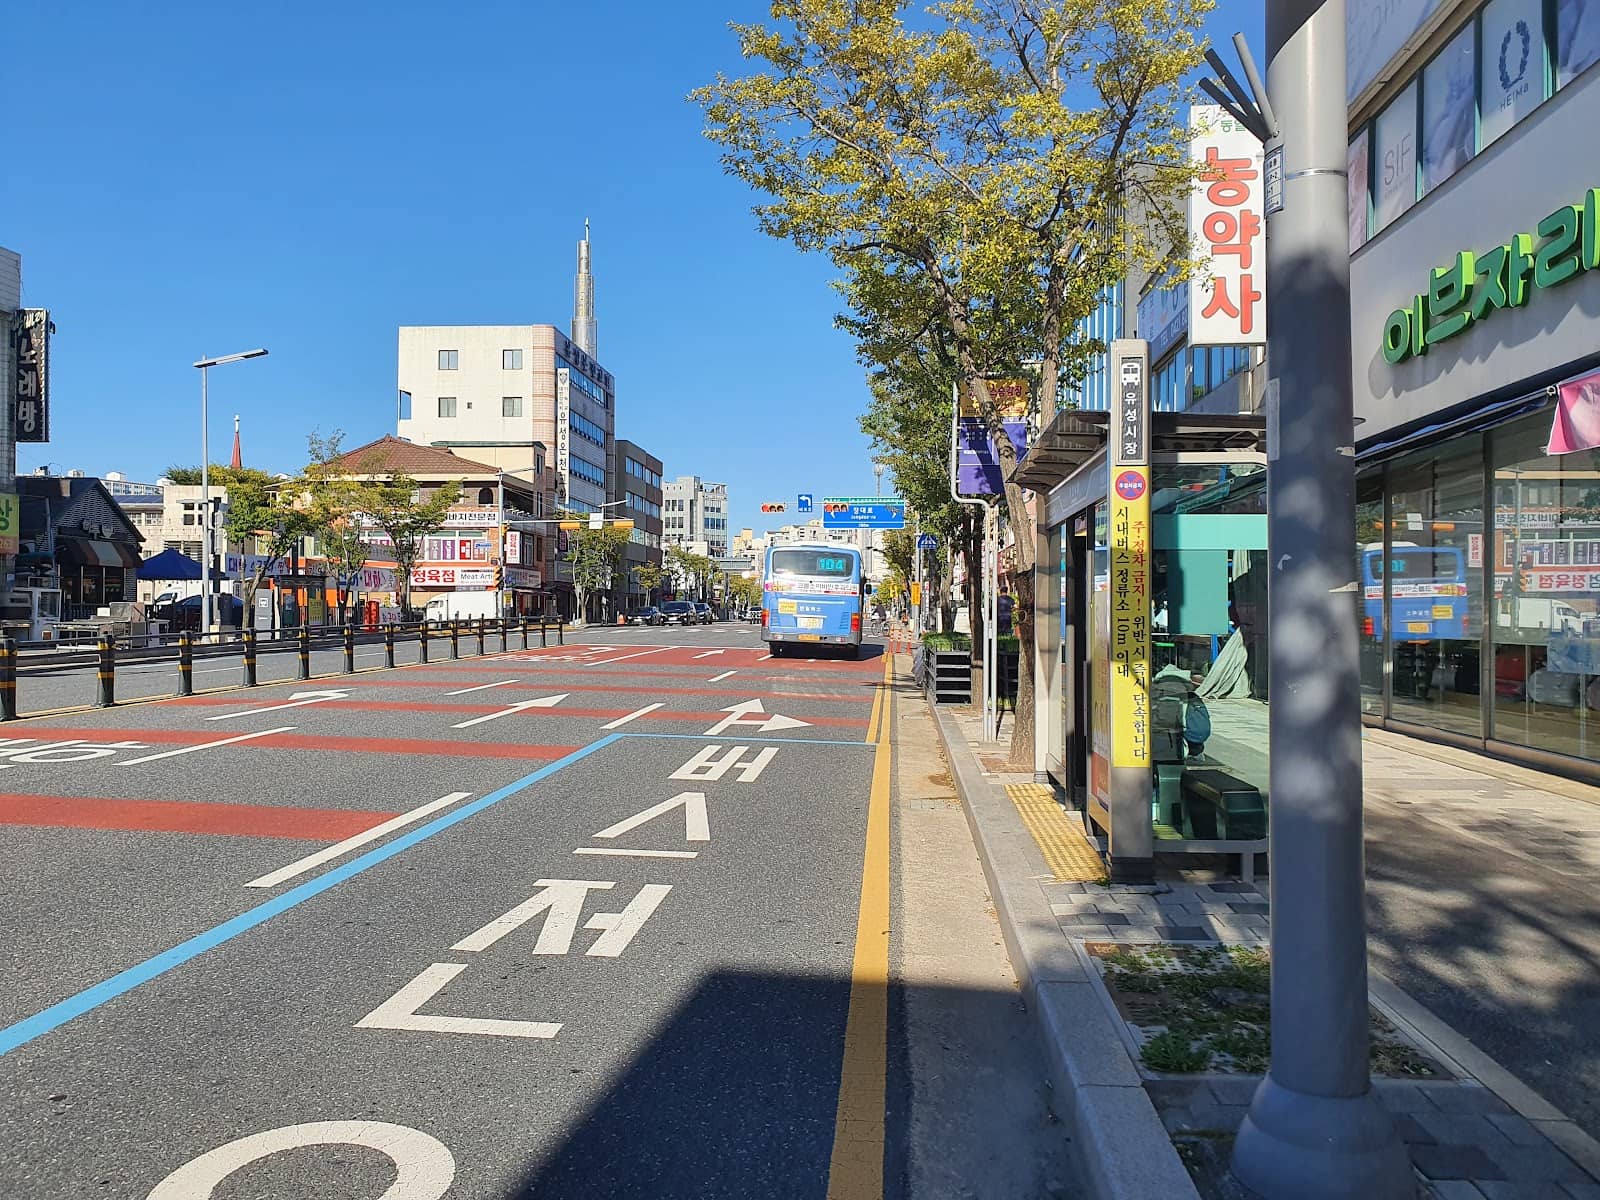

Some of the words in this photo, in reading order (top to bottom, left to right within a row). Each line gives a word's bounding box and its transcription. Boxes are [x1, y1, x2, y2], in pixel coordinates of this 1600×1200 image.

[1384, 133, 1411, 186] SIF
[1199, 146, 1261, 335] 농약사
[1382, 187, 1600, 366] 이브자리
[18, 337, 39, 433] 노래방
[1124, 391, 1138, 455] 유성시장
[1115, 507, 1130, 564] 시내버스
[412, 569, 456, 584] 정육점
[819, 558, 845, 572] 104
[1115, 568, 1130, 611] 정류소
[1117, 617, 1130, 644] 10m
[1116, 650, 1129, 678] 이내
[1133, 663, 1146, 690] 즉시
[1133, 693, 1147, 760] 단속합니다
